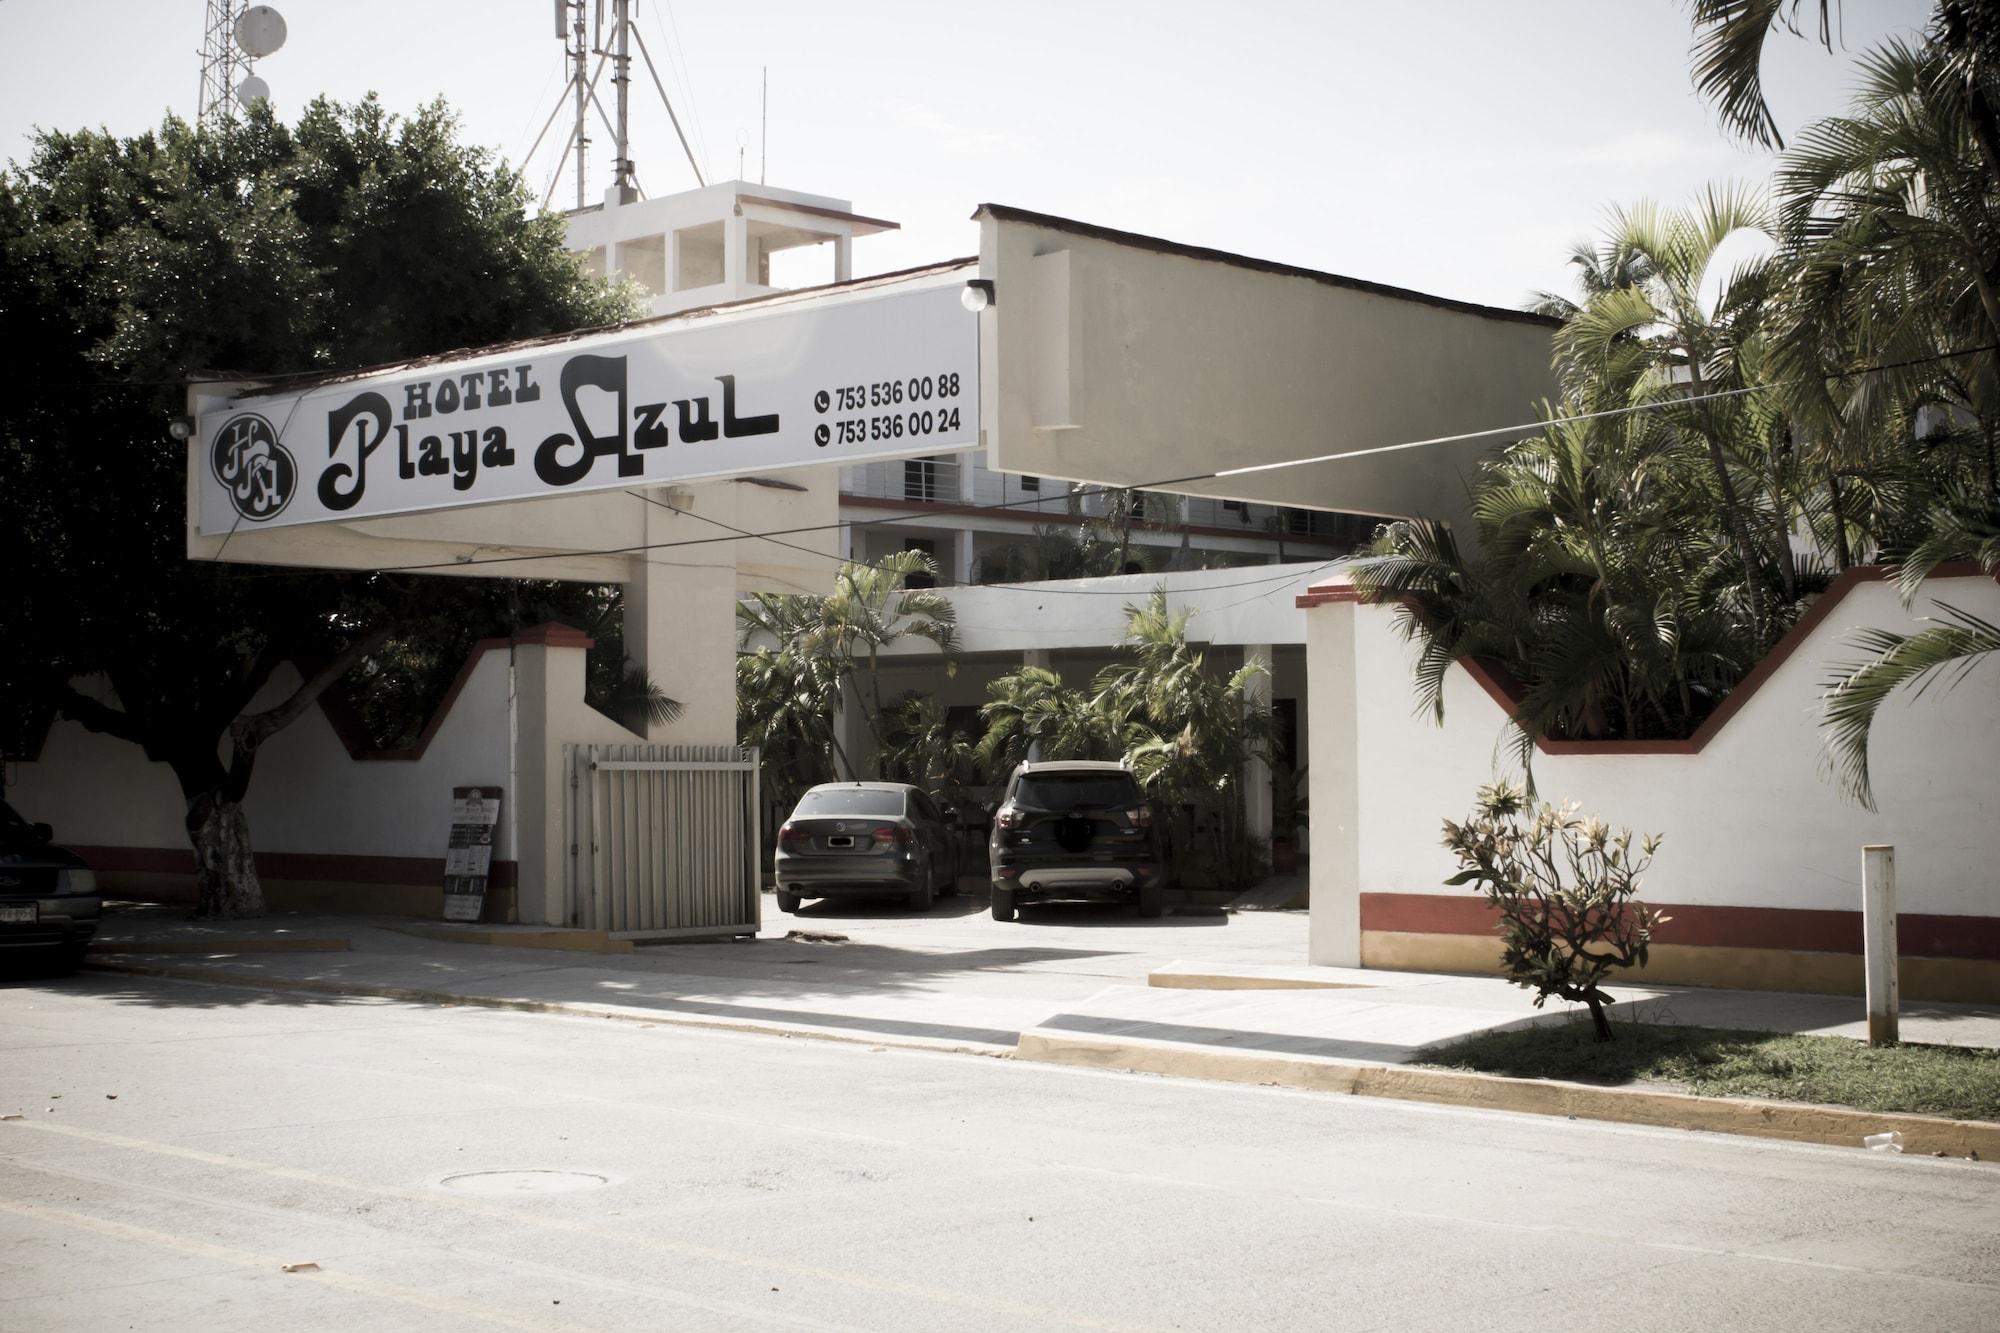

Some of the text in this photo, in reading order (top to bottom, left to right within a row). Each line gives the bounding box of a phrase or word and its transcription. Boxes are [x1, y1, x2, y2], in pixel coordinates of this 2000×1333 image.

[403, 364, 541, 420] HOTEL
[836, 373, 960, 411] 753 536 00 88
[836, 407, 961, 445] 753 536 00 24
[317, 391, 516, 512] Playa
